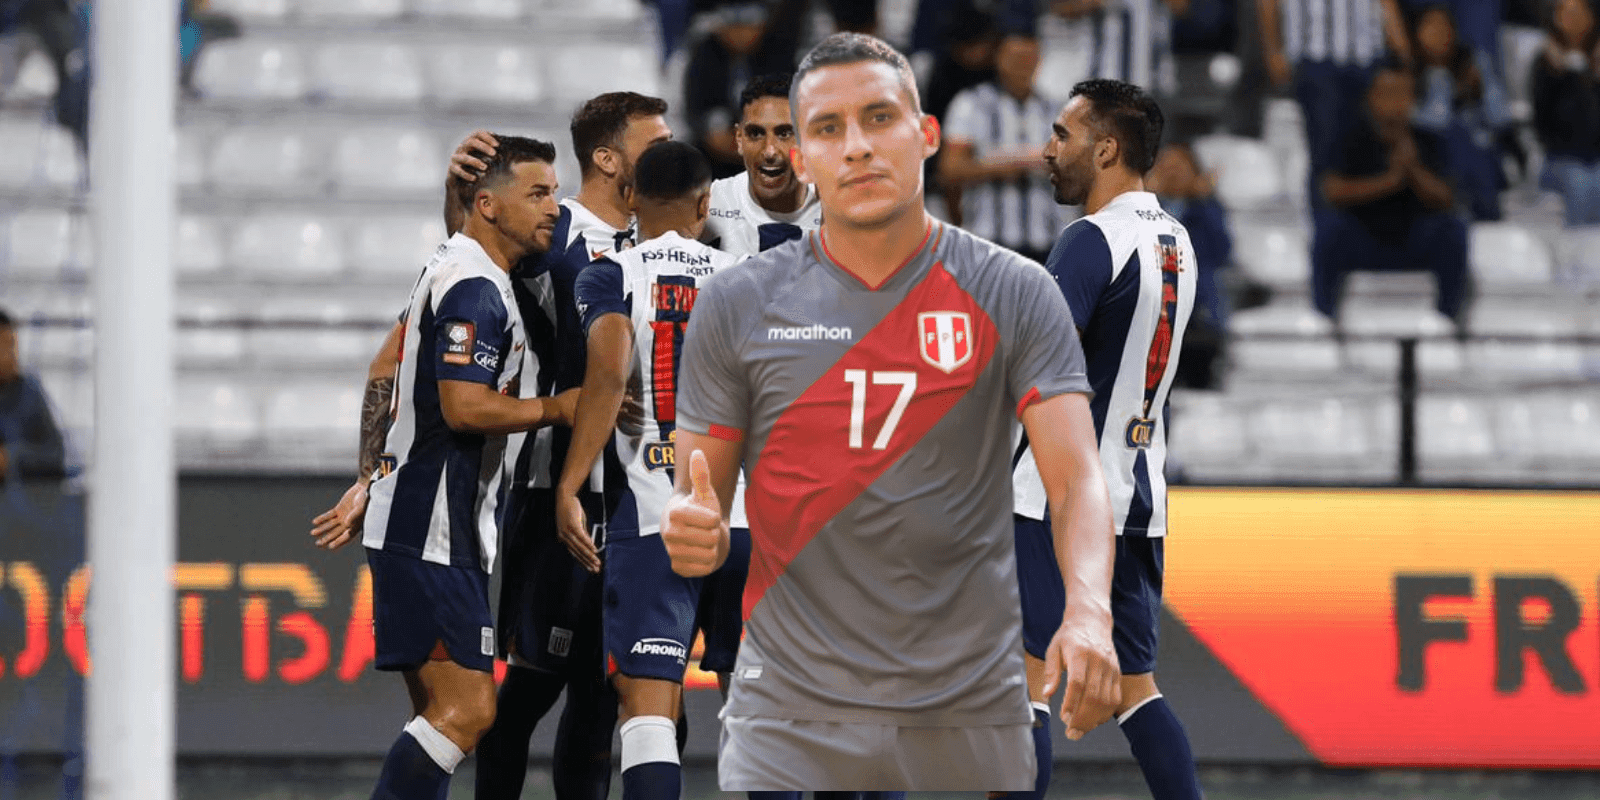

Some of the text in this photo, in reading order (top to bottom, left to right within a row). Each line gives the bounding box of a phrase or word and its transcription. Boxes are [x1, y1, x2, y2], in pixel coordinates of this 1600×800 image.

[768, 324, 852, 340] marathon
[844, 369, 918, 450] 17
[1393, 573, 1600, 695] FR
